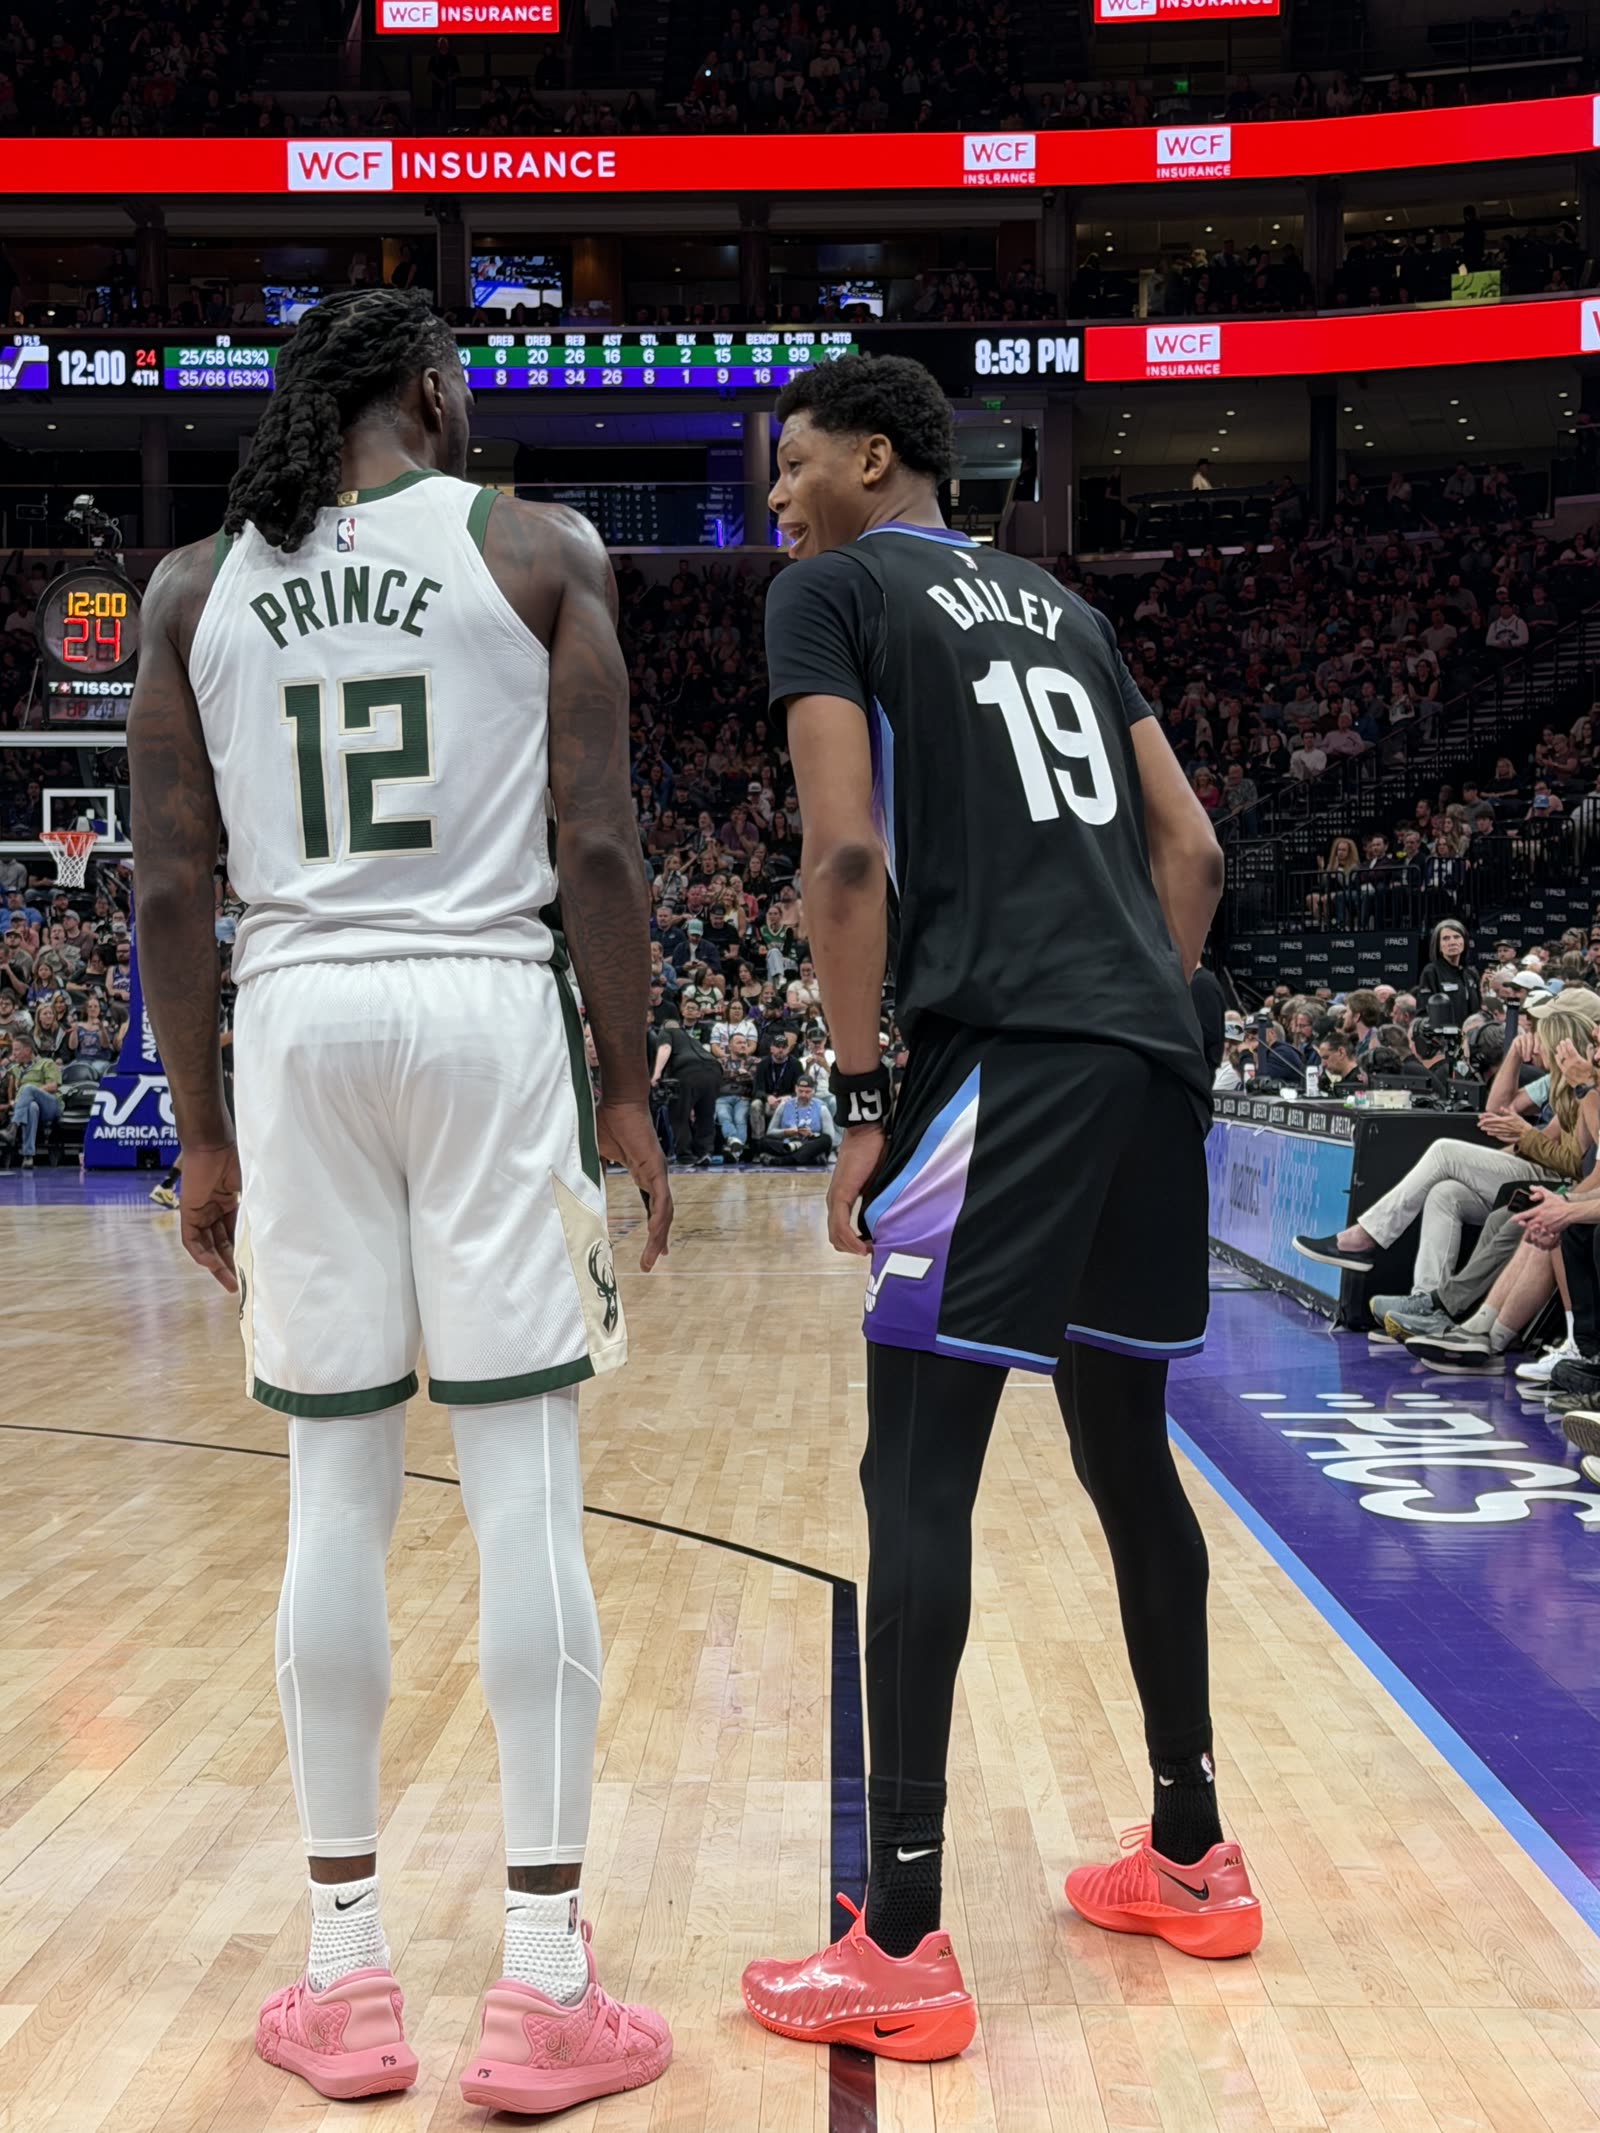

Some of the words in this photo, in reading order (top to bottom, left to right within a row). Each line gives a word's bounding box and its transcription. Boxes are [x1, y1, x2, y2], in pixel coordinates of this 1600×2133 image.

[389, 7, 433, 22] WCF
[441, 6, 552, 22] INSURANCE
[971, 142, 1028, 162] WCF
[1165, 135, 1224, 156] WCF
[298, 152, 383, 180] WCF
[401, 151, 616, 179] INSURANCE
[1156, 164, 1231, 179] INSURANCE
[525, 335, 551, 346] DREB
[565, 335, 585, 346] REB
[602, 335, 622, 346] AST
[640, 335, 658, 346] STL
[675, 334, 696, 345] BLK
[713, 334, 733, 345] TOV
[746, 333, 779, 345] BENCH
[1154, 334, 1213, 355] WCF
[135, 350, 156, 366] 24
[179, 350, 225, 366] 25/58
[227, 350, 269, 366] (43%)
[495, 349, 507, 364] 6
[528, 349, 549, 364] 20
[565, 349, 585, 364] 26
[603, 349, 621, 364] 16
[643, 349, 655, 364] 6
[680, 348, 691, 363] 2
[714, 348, 731, 363] 15
[752, 347, 773, 362] 33
[788, 347, 809, 362] 99
[975, 339, 1030, 374] 8:53
[1038, 337, 1079, 374] PM
[57, 350, 126, 386] 12:00
[132, 371, 158, 386] 4TH
[179, 371, 225, 387] 35/66
[227, 371, 269, 387] (53%)
[496, 370, 507, 385] 8
[528, 370, 549, 385] 26
[565, 370, 586, 385] 34
[602, 370, 622, 385] 26
[643, 370, 655, 385] 8
[682, 369, 690, 384] 1
[717, 369, 729, 384] 9
[753, 369, 771, 384] 16
[1146, 363, 1220, 377] INSURANCE
[68, 591, 127, 618] 12:00
[250, 566, 443, 649] PRINCE
[927, 578, 1063, 641] BAILEY
[63, 617, 121, 662] 24
[72, 681, 135, 695] TISSOT
[972, 660, 1117, 826] 19
[278, 669, 439, 866] 12
[848, 1089, 882, 1121] 19
[94, 1126, 158, 1139] AMERICA
[1260, 1412, 1600, 1522] PACS
